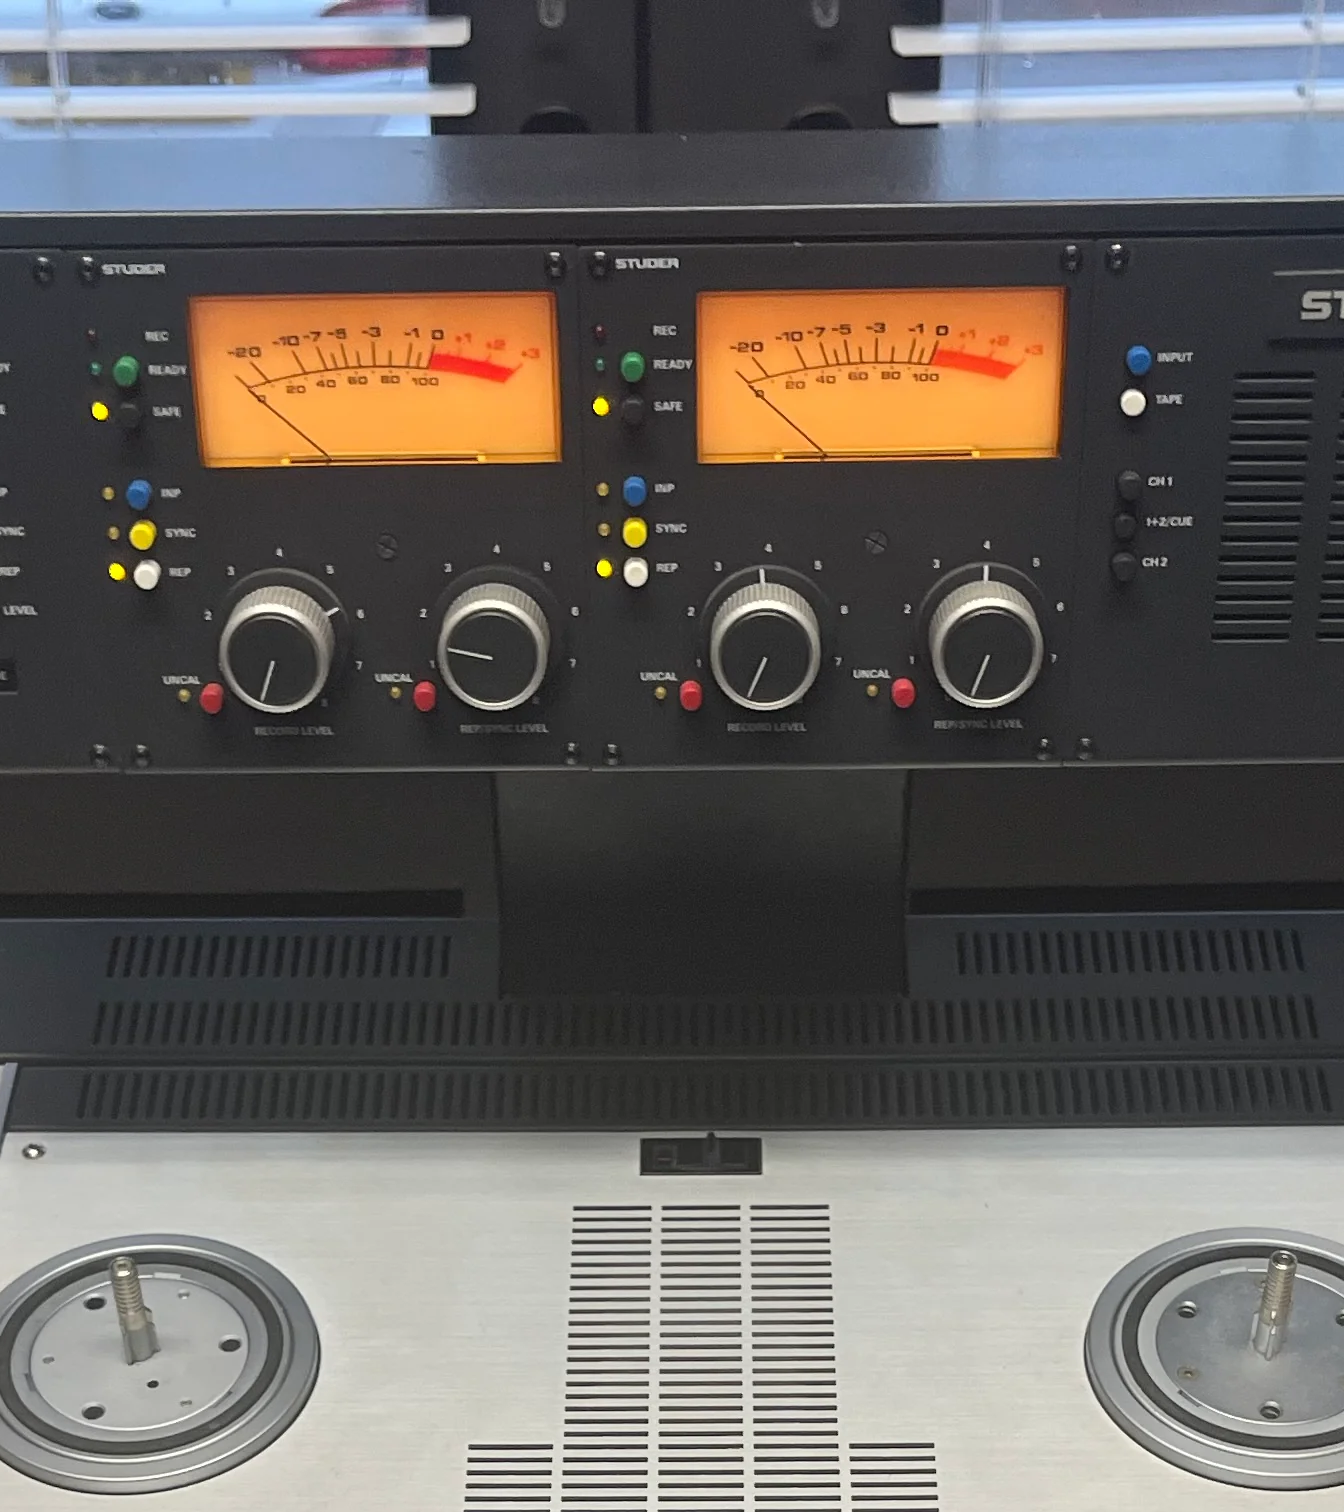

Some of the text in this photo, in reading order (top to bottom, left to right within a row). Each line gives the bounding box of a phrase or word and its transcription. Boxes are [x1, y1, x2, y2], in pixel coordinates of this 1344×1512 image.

[101, 263, 166, 275] STUDER
[615, 258, 680, 269] STUDER
[431, 329, 444, 341] 0
[652, 325, 677, 336] REC
[935, 325, 949, 337] 0
[1157, 352, 1193, 363] INPUT
[653, 359, 693, 370] READY
[316, 379, 336, 389] 40
[412, 377, 439, 387] 100
[816, 375, 836, 384] 40
[912, 373, 939, 382] 100
[1156, 394, 1183, 405] TAPE
[654, 401, 683, 412] SAFE
[1148, 476, 1164, 487] CH
[164, 528, 196, 538] SYNC
[655, 523, 687, 534] SYNC
[1142, 557, 1168, 567] CH 2
[656, 563, 678, 573] REP
[3, 606, 38, 616] LEVEL
[375, 673, 414, 683] UNCAL
[640, 671, 678, 681] UNCAL
[853, 669, 891, 679] UNCAL
[162, 675, 201, 685] UNCAL
[515, 723, 549, 733] LEVEL
[774, 722, 807, 732] LEVEL
[990, 719, 1024, 729] LEVEL
